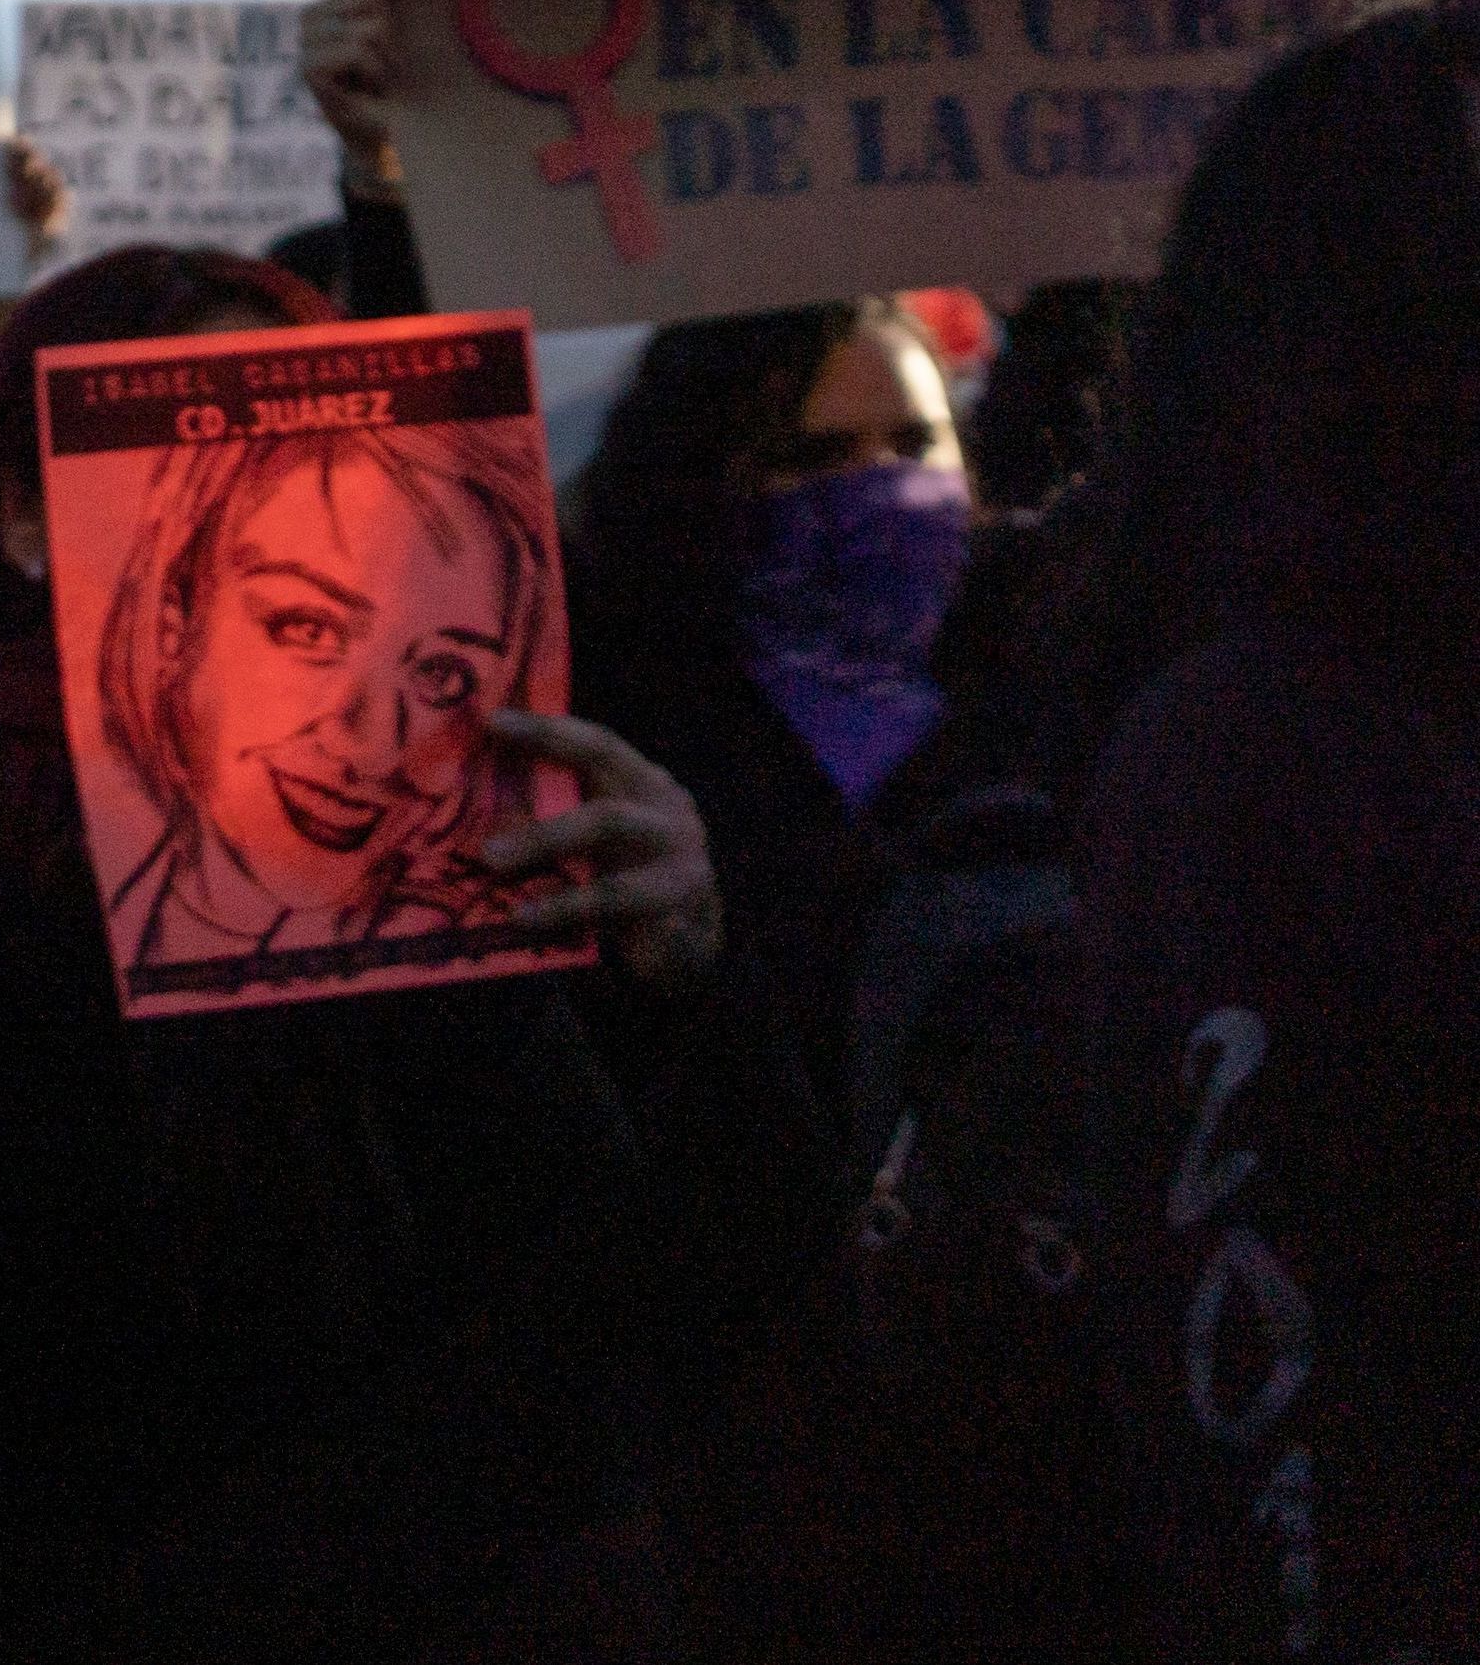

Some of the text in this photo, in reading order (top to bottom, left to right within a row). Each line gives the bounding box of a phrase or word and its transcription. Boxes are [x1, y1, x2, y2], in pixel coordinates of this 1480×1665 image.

[663, 104, 815, 207] DE
[853, 93, 988, 191] LA
[83, 367, 217, 406] ISABEL
